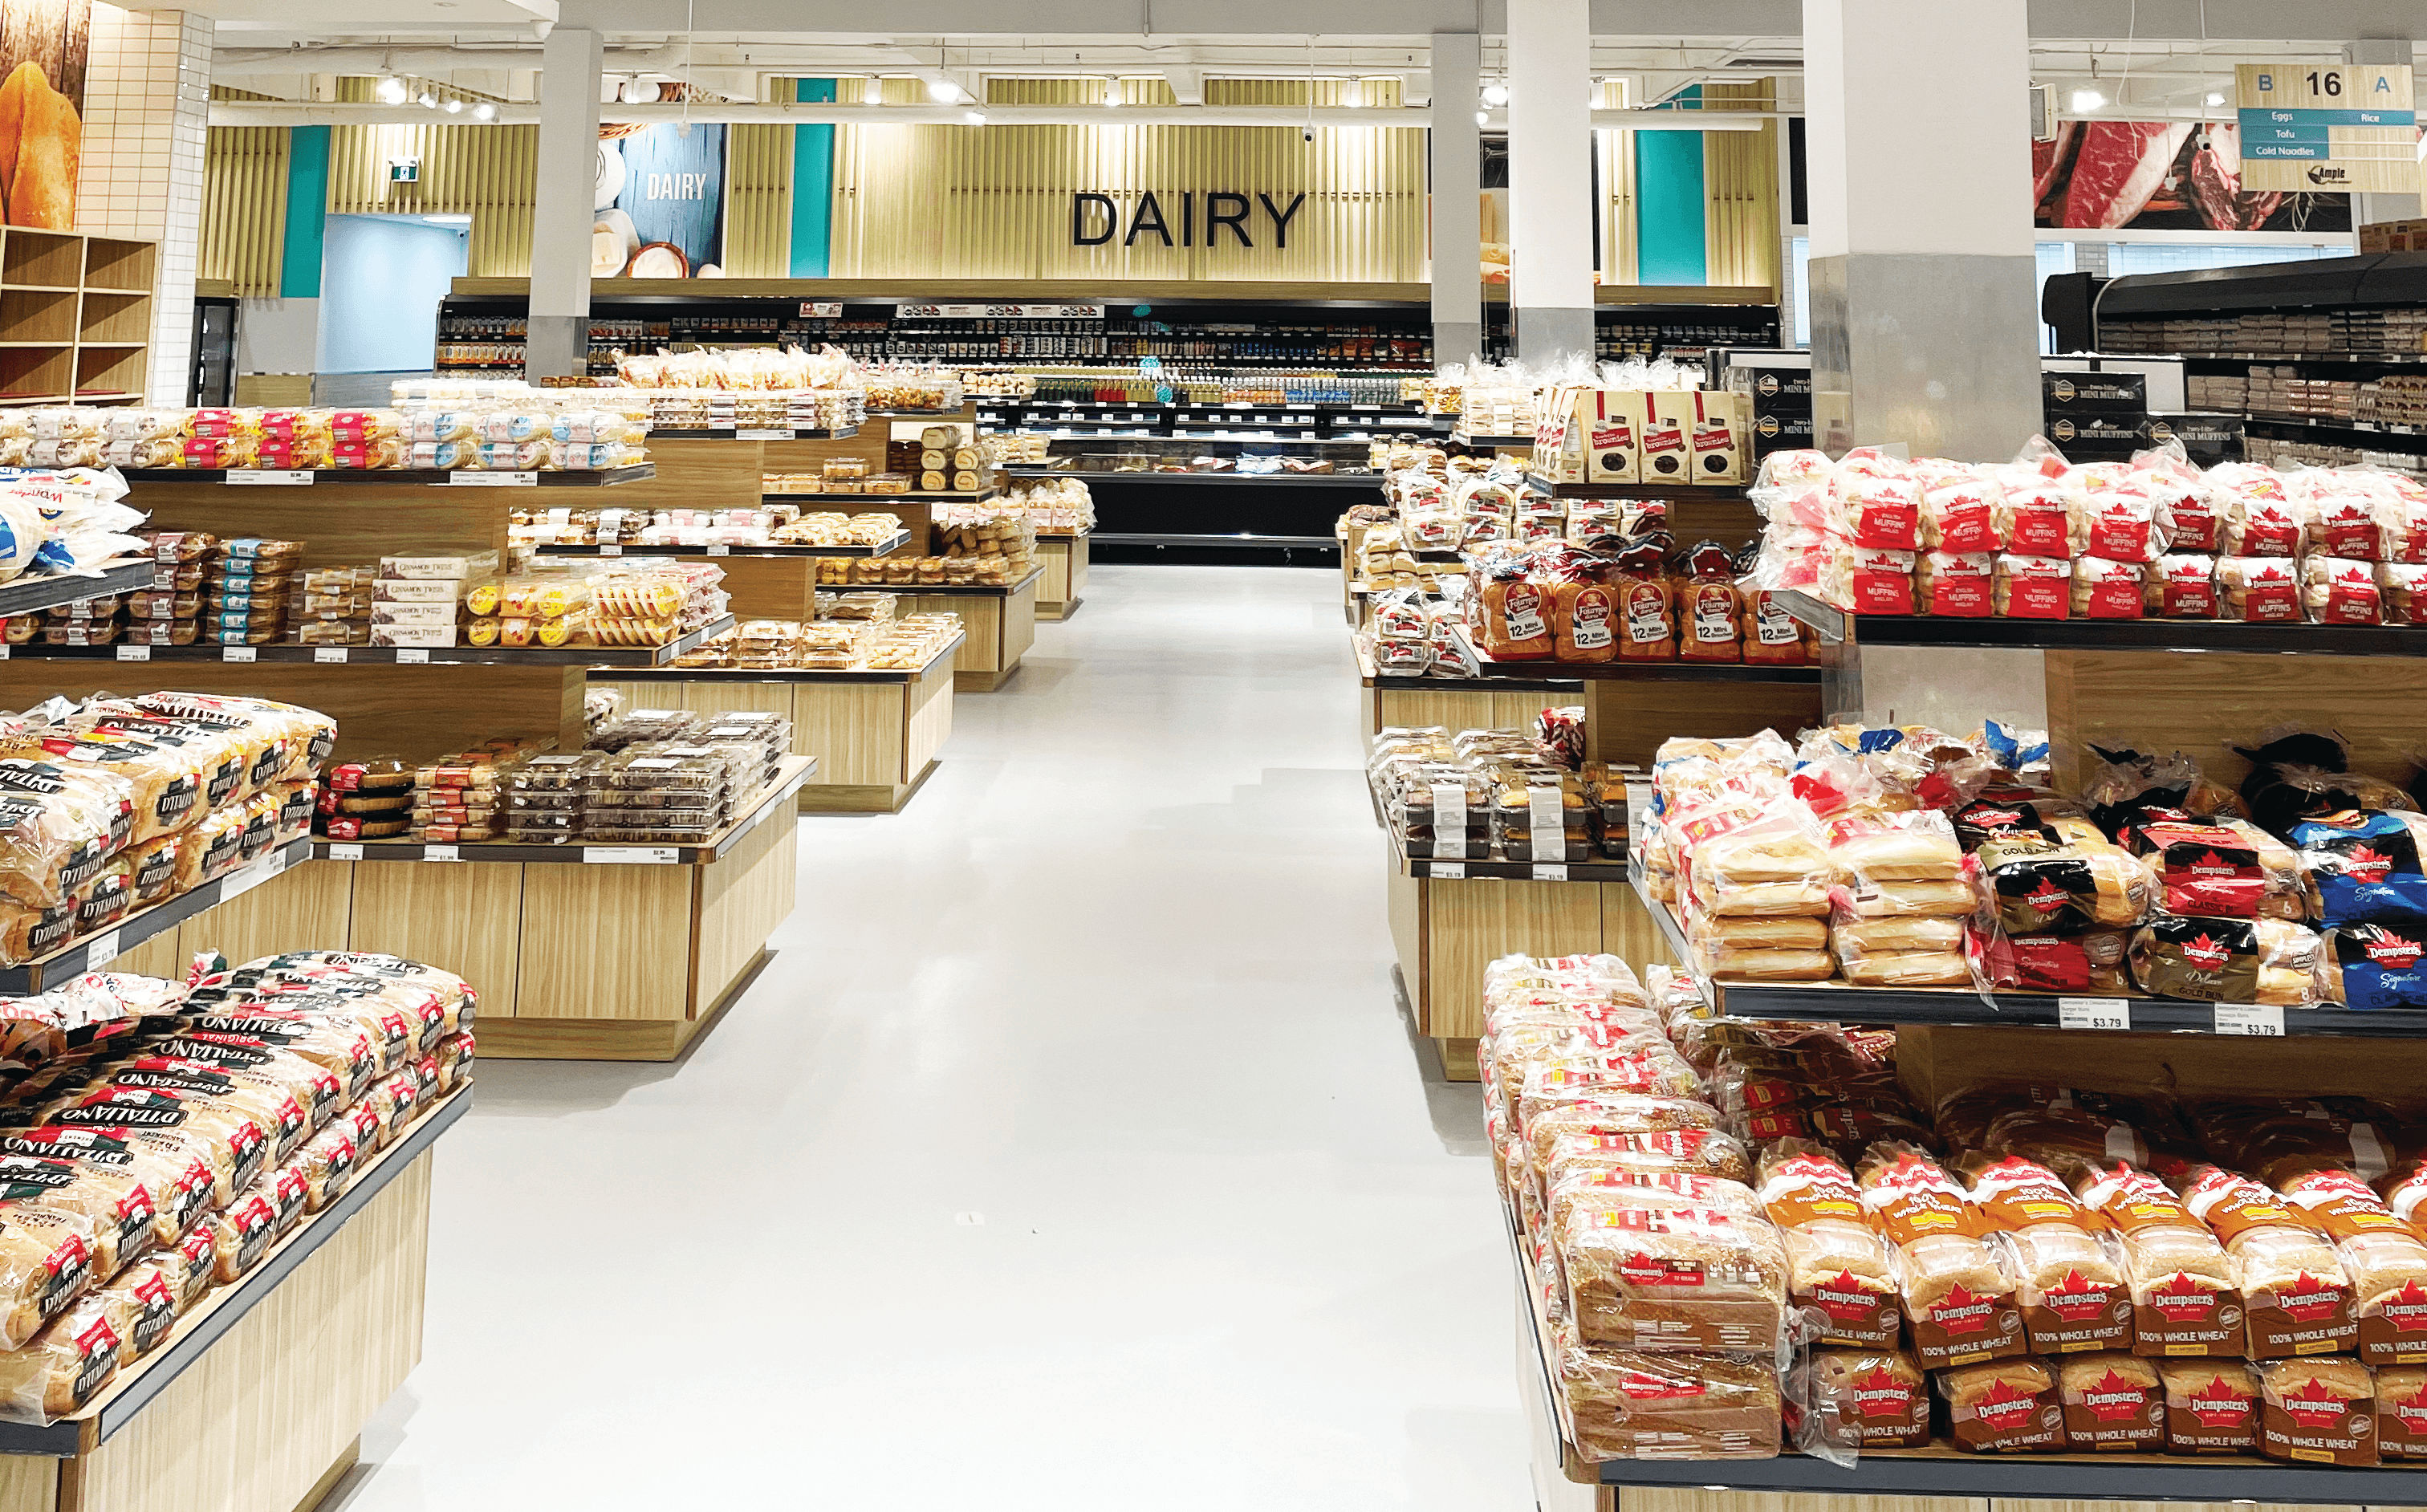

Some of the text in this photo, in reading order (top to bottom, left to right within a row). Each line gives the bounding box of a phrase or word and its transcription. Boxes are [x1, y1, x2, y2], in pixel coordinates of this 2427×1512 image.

[2258, 72, 2391, 96] B 16 A
[2272, 112, 2380, 123] Eggs Rice
[2275, 129, 2295, 138] Tofu
[2256, 147, 2315, 156] Cold Noodles
[2319, 168, 2345, 179] Ample
[647, 173, 707, 200] DAIRY
[1074, 192, 1306, 248] DAIRY
[1783, 384, 1803, 393] MINI
[2079, 390, 2135, 400] MINI MUFS
[1783, 425, 1803, 434] MINI
[2079, 430, 2134, 439] MINI MUFFINS
[1593, 434, 1629, 445] brownies
[1694, 437, 1730, 448] brownies
[2177, 432, 2231, 441] MINI MUFFINS
[1644, 437, 1681, 449] brownies
[2169, 506, 2210, 518] Dempster
[1874, 518, 1906, 529] MUFFINS
[2026, 529, 2057, 538] MUFFINS
[2103, 537, 2137, 547] MUFFINS
[2255, 542, 2288, 552] MUFFINS
[2338, 542, 2369, 551] MUFFINS
[2171, 574, 2210, 584] Dempster
[1867, 587, 1900, 597] MUFFINS
[1949, 593, 1982, 602] MUFFINS
[2024, 594, 2058, 604] MUFFINS
[2176, 600, 2209, 608] MUFFINS
[2258, 604, 2291, 612] MUFFINS
[2340, 604, 2372, 616] MUFFINS
[1510, 625, 1523, 637] 12
[1632, 628, 1647, 640] 12
[1697, 627, 1710, 638] 12
[1760, 629, 1774, 640] 12
[1575, 633, 1589, 645] 12
[2191, 866, 2236, 876] Dempster's
[2027, 891, 2069, 905] Dempster's
[2283, 903, 2292, 914] 6
[2184, 946, 2229, 962] Dempster's
[2369, 945, 2421, 959] Dempster's
[2179, 987, 2224, 1001] GOLD BUN
[2301, 986, 2310, 1001] 8
[202, 1016, 312, 1036] ITALIANO
[2093, 1018, 2121, 1028] $3.79
[2247, 1024, 2276, 1035] $3.79
[62, 1104, 180, 1127] D'ITALIANO
[4, 1136, 127, 1164] D'ITALIANO
[1831, 1193, 1861, 1203] WHEA
[2003, 1193, 2041, 1205] WHOLE
[1817, 1289, 1876, 1307] Dempster's
[2049, 1290, 2108, 1308] Dempster's
[2156, 1293, 2215, 1307] Dempster's
[2280, 1289, 2340, 1308] Dempster's
[1933, 1301, 1993, 1323] Dempster's
[2385, 1303, 2427, 1317] Dempst
[1823, 1327, 1888, 1342] WHOLE WHEAT
[2034, 1326, 2124, 1342] 100% WHOLE WHEAT
[2139, 1331, 2230, 1342] 100% WHOLE WHEAT
[2268, 1324, 2358, 1344] 100% WHOLE WHEAT
[1922, 1336, 2012, 1356] 100% WHOLE WHEAT
[2370, 1341, 2427, 1352] 100% WHOLE
[1853, 1388, 1909, 1403] Dempster's
[2087, 1390, 2144, 1406] Dempster's
[1978, 1398, 2034, 1418] Dempster's
[2192, 1399, 2249, 1412] Dempster's
[2286, 1398, 2345, 1414] Dempster's
[1862, 1427, 1893, 1437] WHOLE
[2022, 1432, 2053, 1444] WHEAT
[2070, 1428, 2158, 1441] 100% WHOLE WHEAT
[2173, 1433, 2255, 1446] 100% WHOLE WHEA
[2266, 1429, 2359, 1450] 100% WHOLE WHEAT
[2380, 1441, 2427, 1453] 100% WHO
